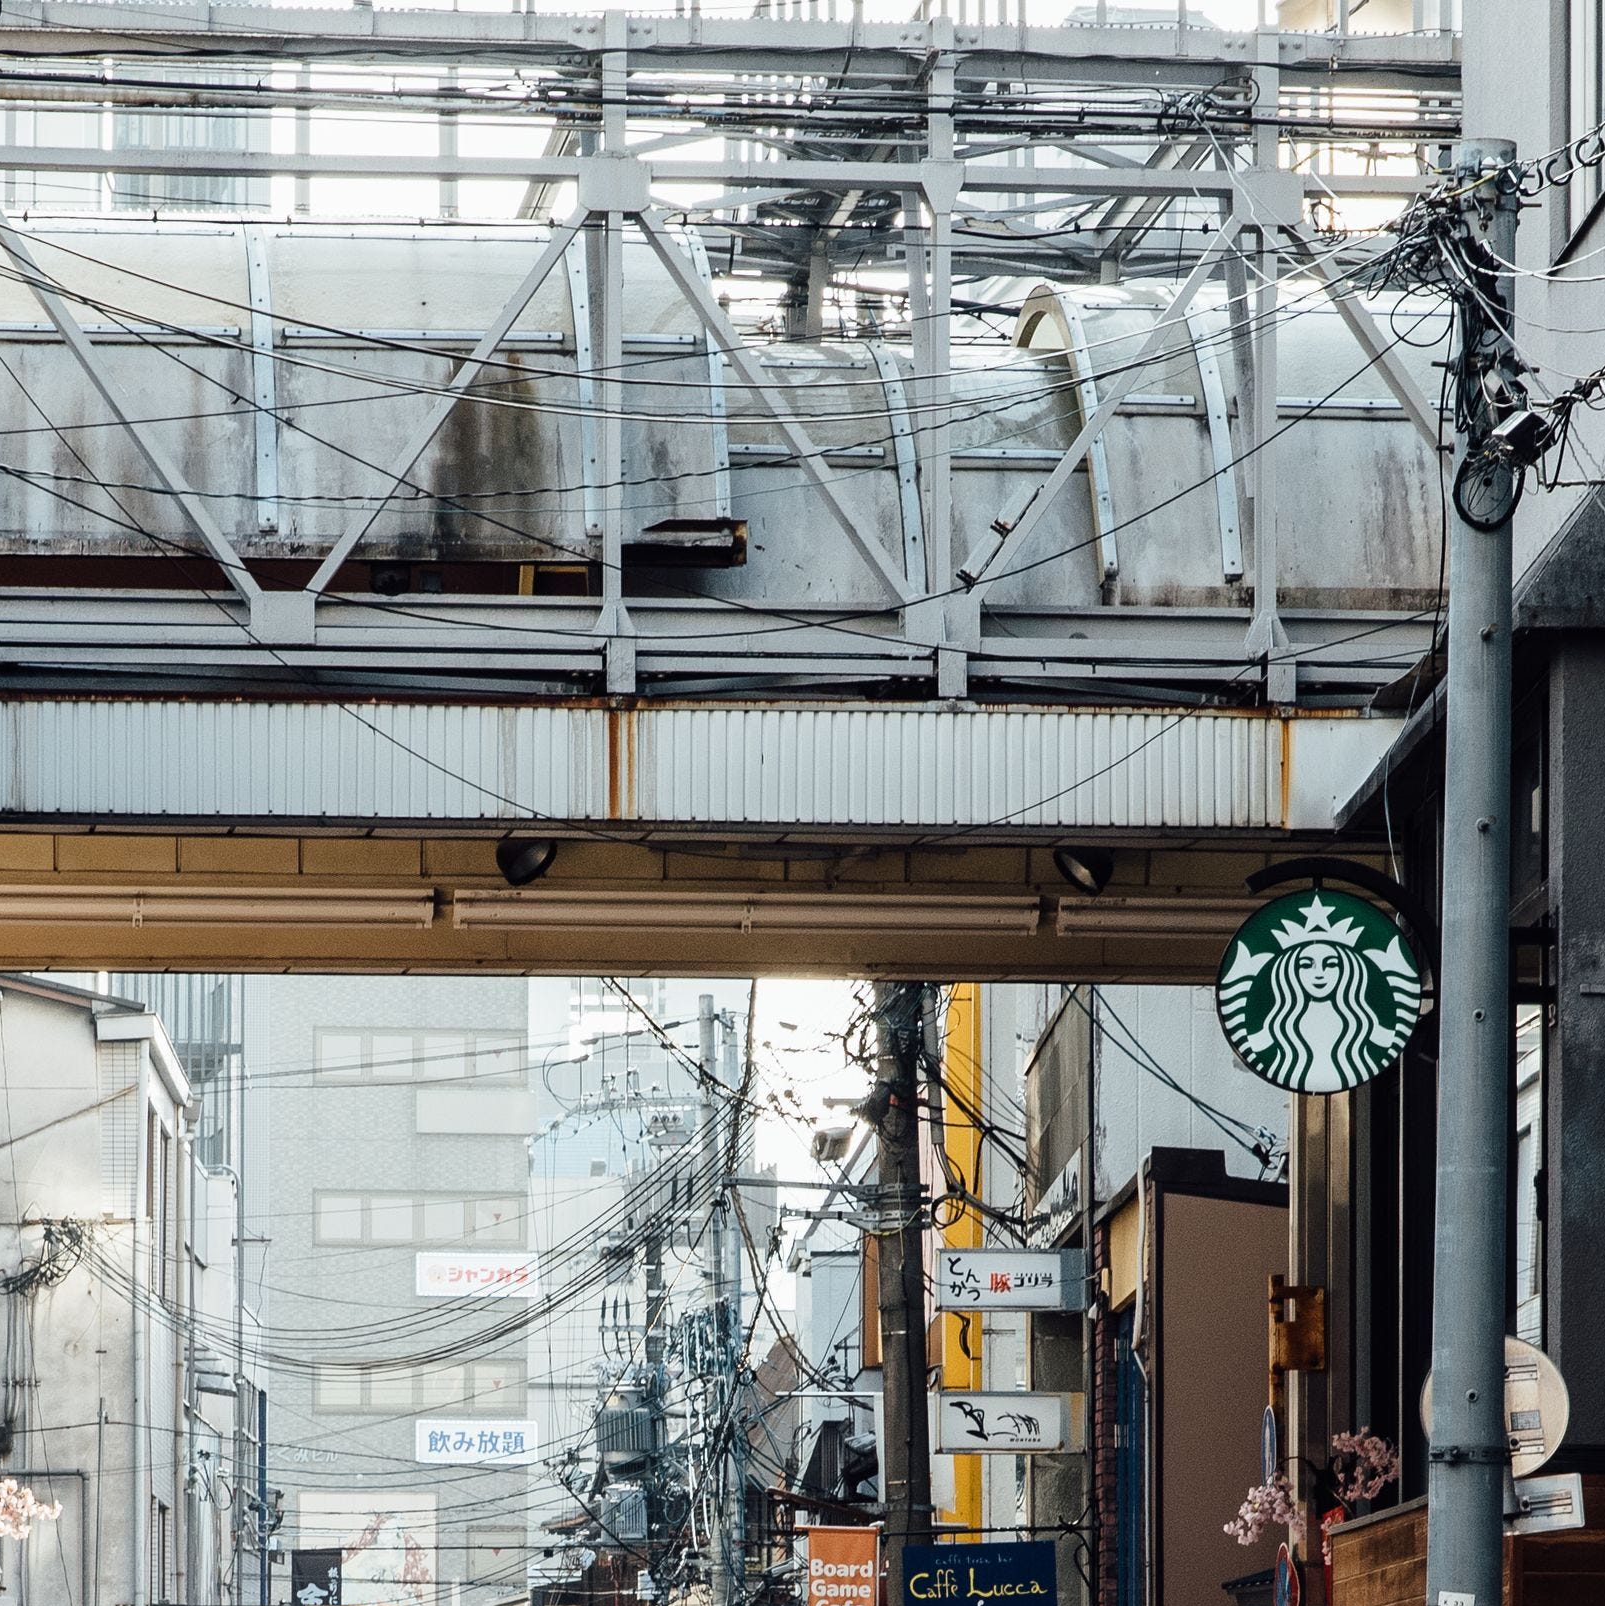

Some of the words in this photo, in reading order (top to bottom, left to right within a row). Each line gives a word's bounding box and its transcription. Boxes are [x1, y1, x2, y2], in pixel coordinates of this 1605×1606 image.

[428, 1430, 525, 1454] 飲み放題
[810, 1558, 874, 1578] Board
[810, 1579, 872, 1599] Game
[966, 1567, 1049, 1598] Lucca
